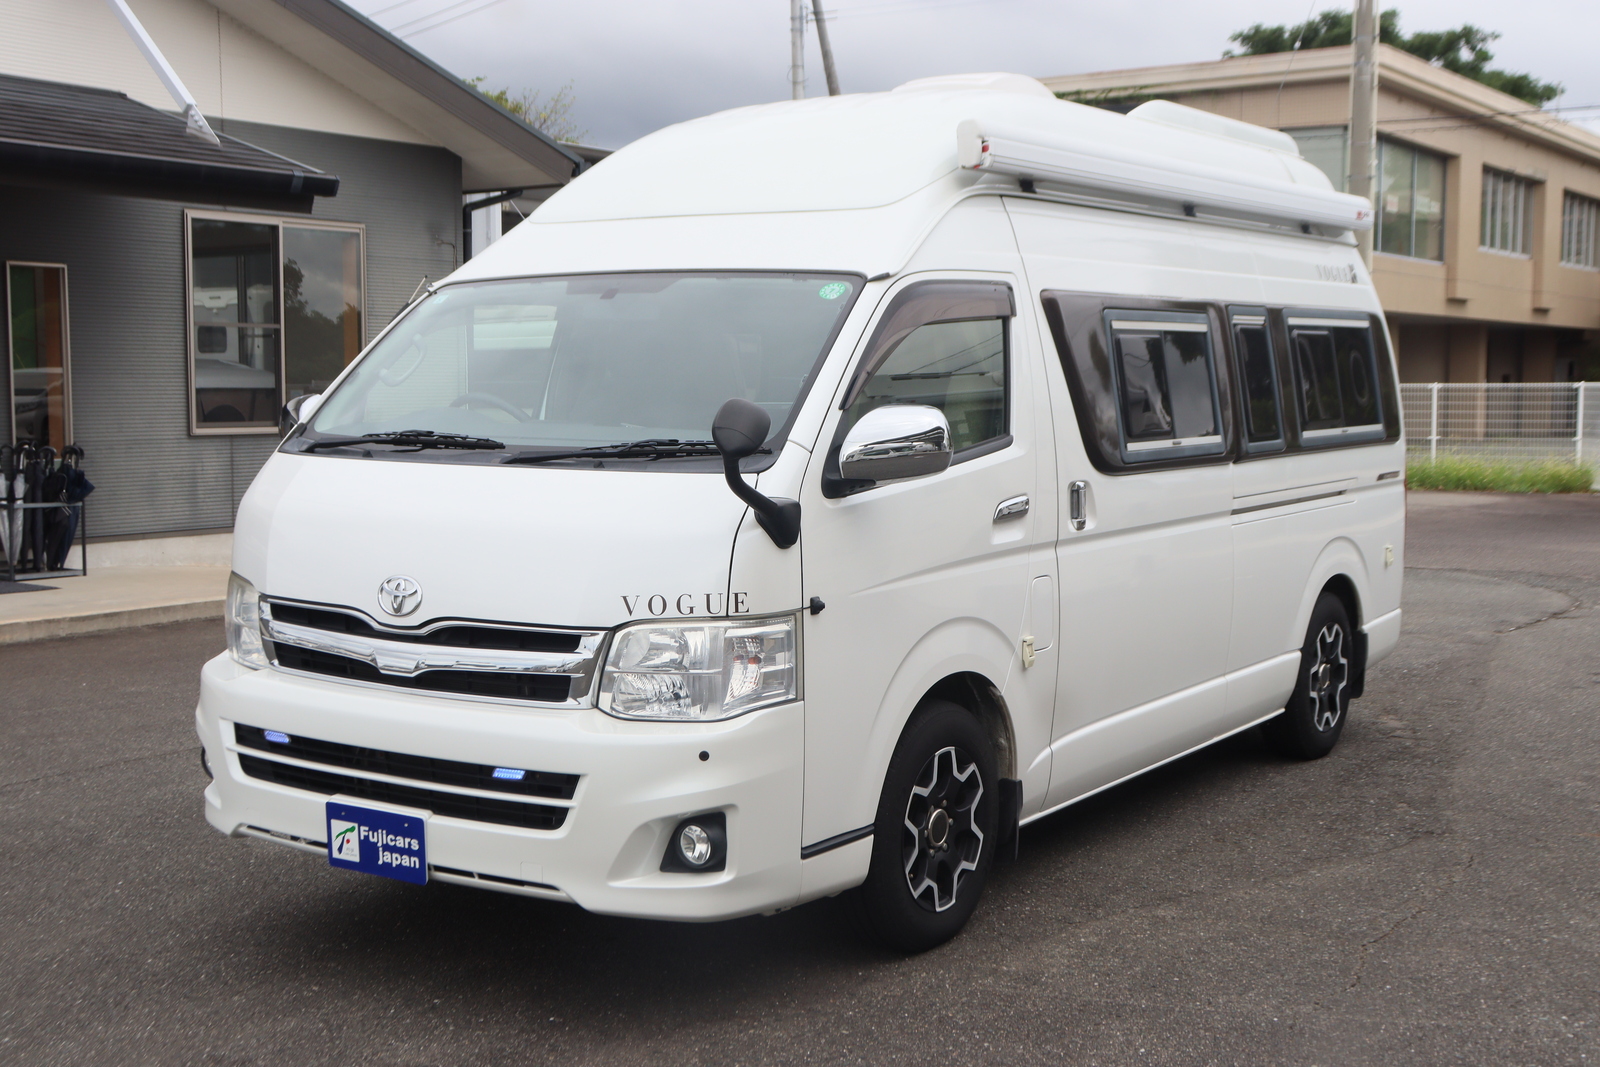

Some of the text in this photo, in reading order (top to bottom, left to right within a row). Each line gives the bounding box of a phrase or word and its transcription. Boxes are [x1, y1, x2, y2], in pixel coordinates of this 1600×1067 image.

[620, 592, 750, 617] VOGUE
[360, 826, 419, 850] Fujicars
[378, 847, 419, 868] japan
